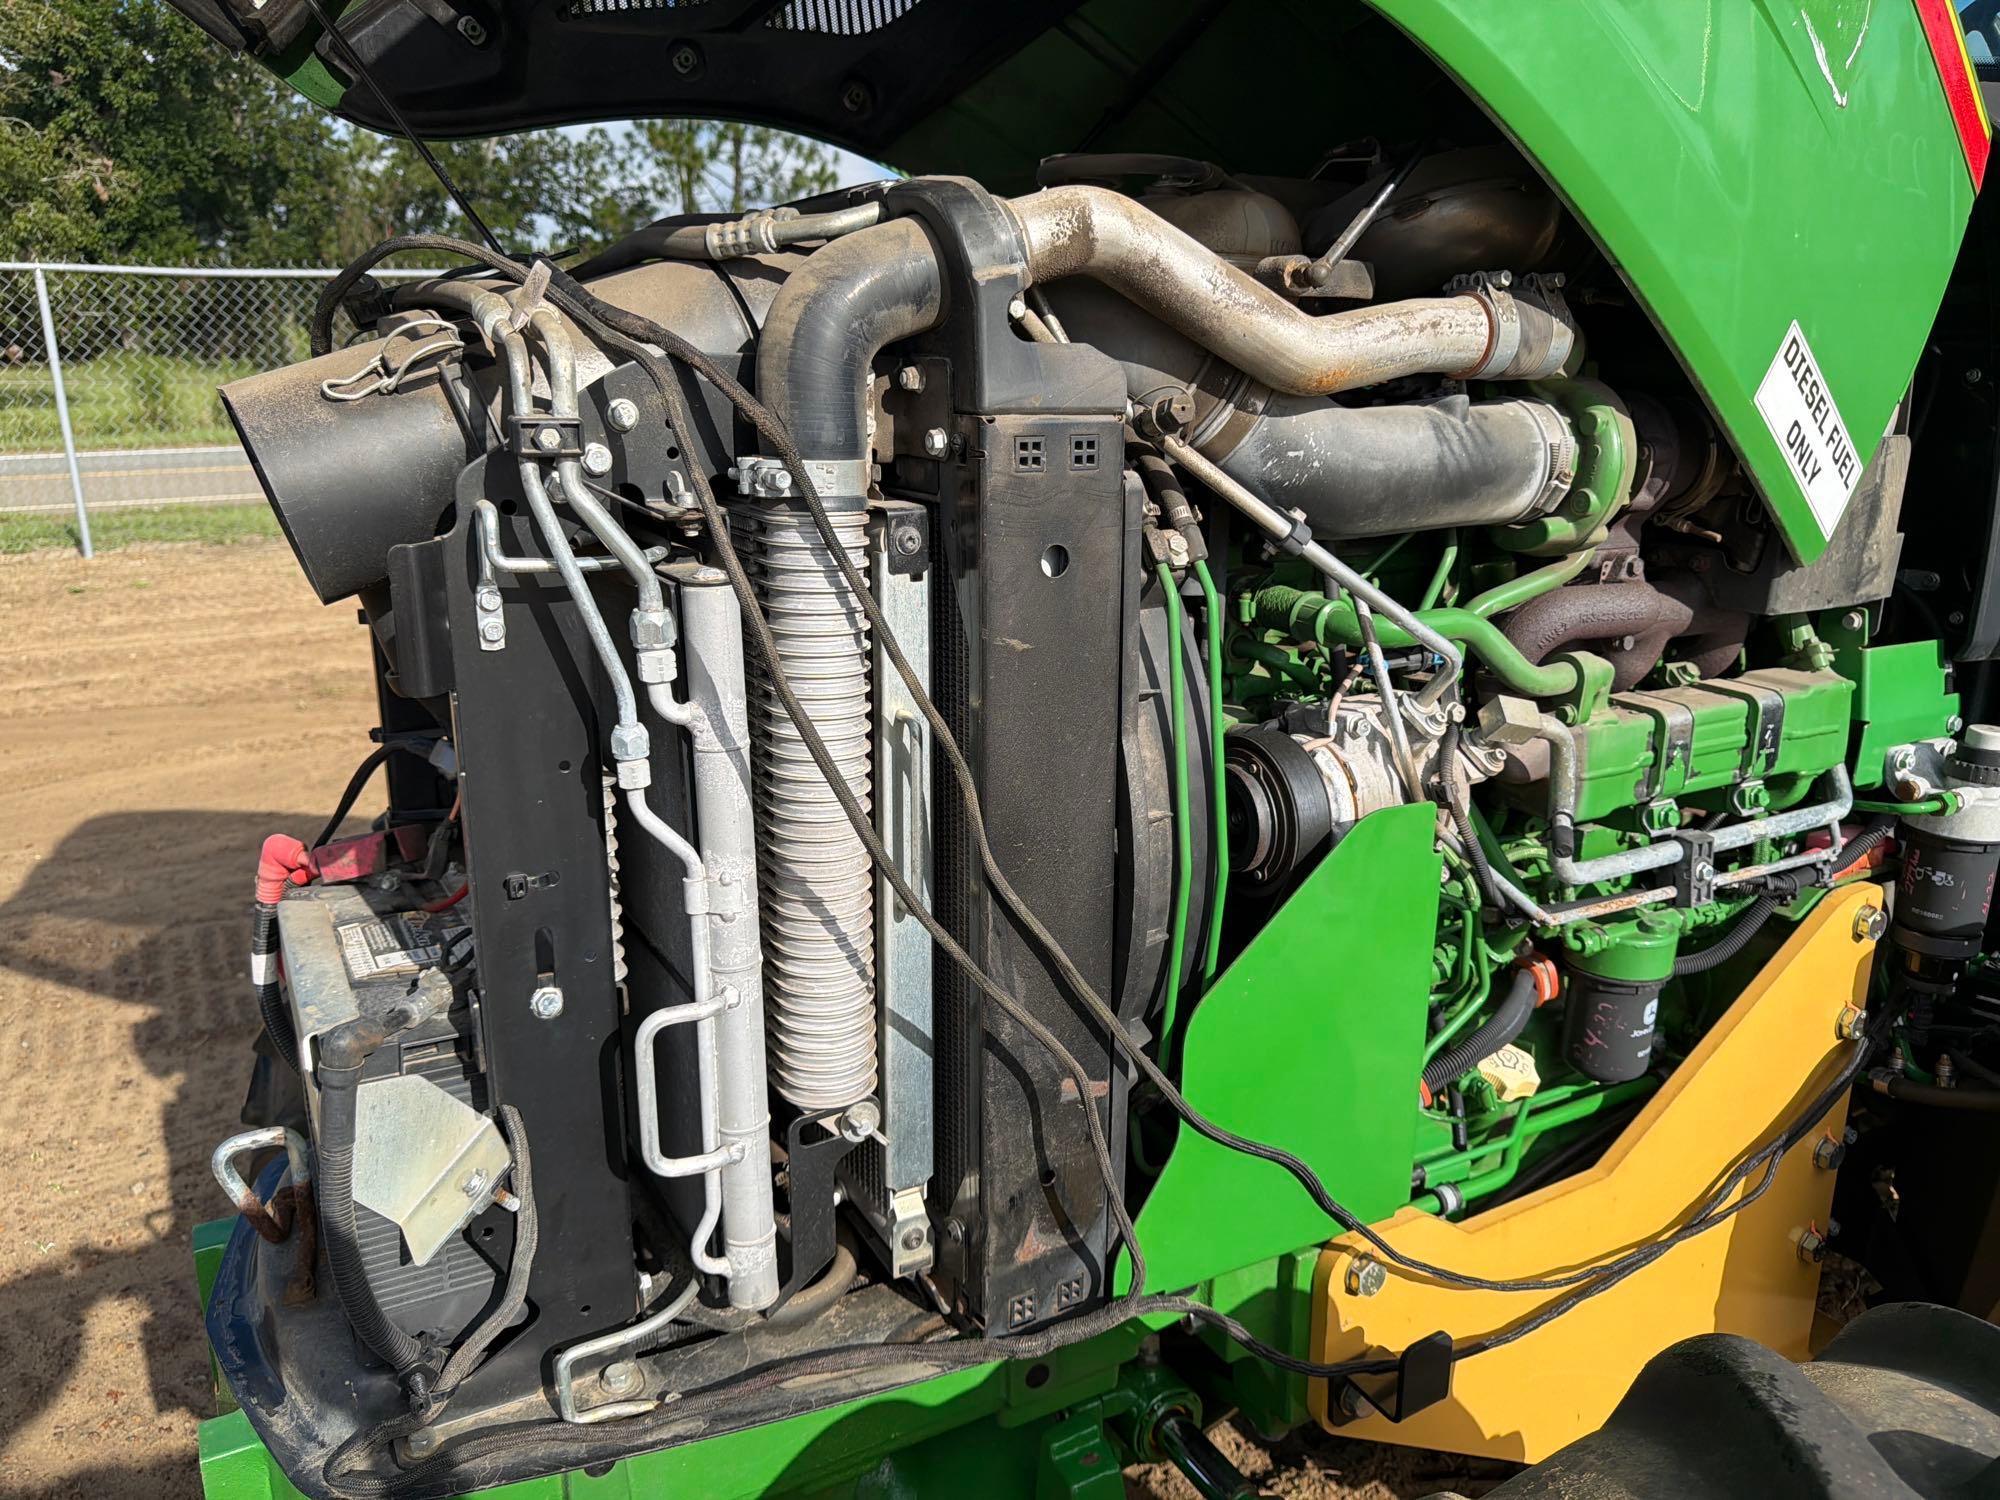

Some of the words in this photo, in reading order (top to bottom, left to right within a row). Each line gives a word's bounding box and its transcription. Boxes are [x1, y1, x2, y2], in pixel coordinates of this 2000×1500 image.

[1784, 335, 1830, 437] DIESEL
[1826, 424, 1856, 491] FUEL
[1786, 419, 1822, 487] ONLY
